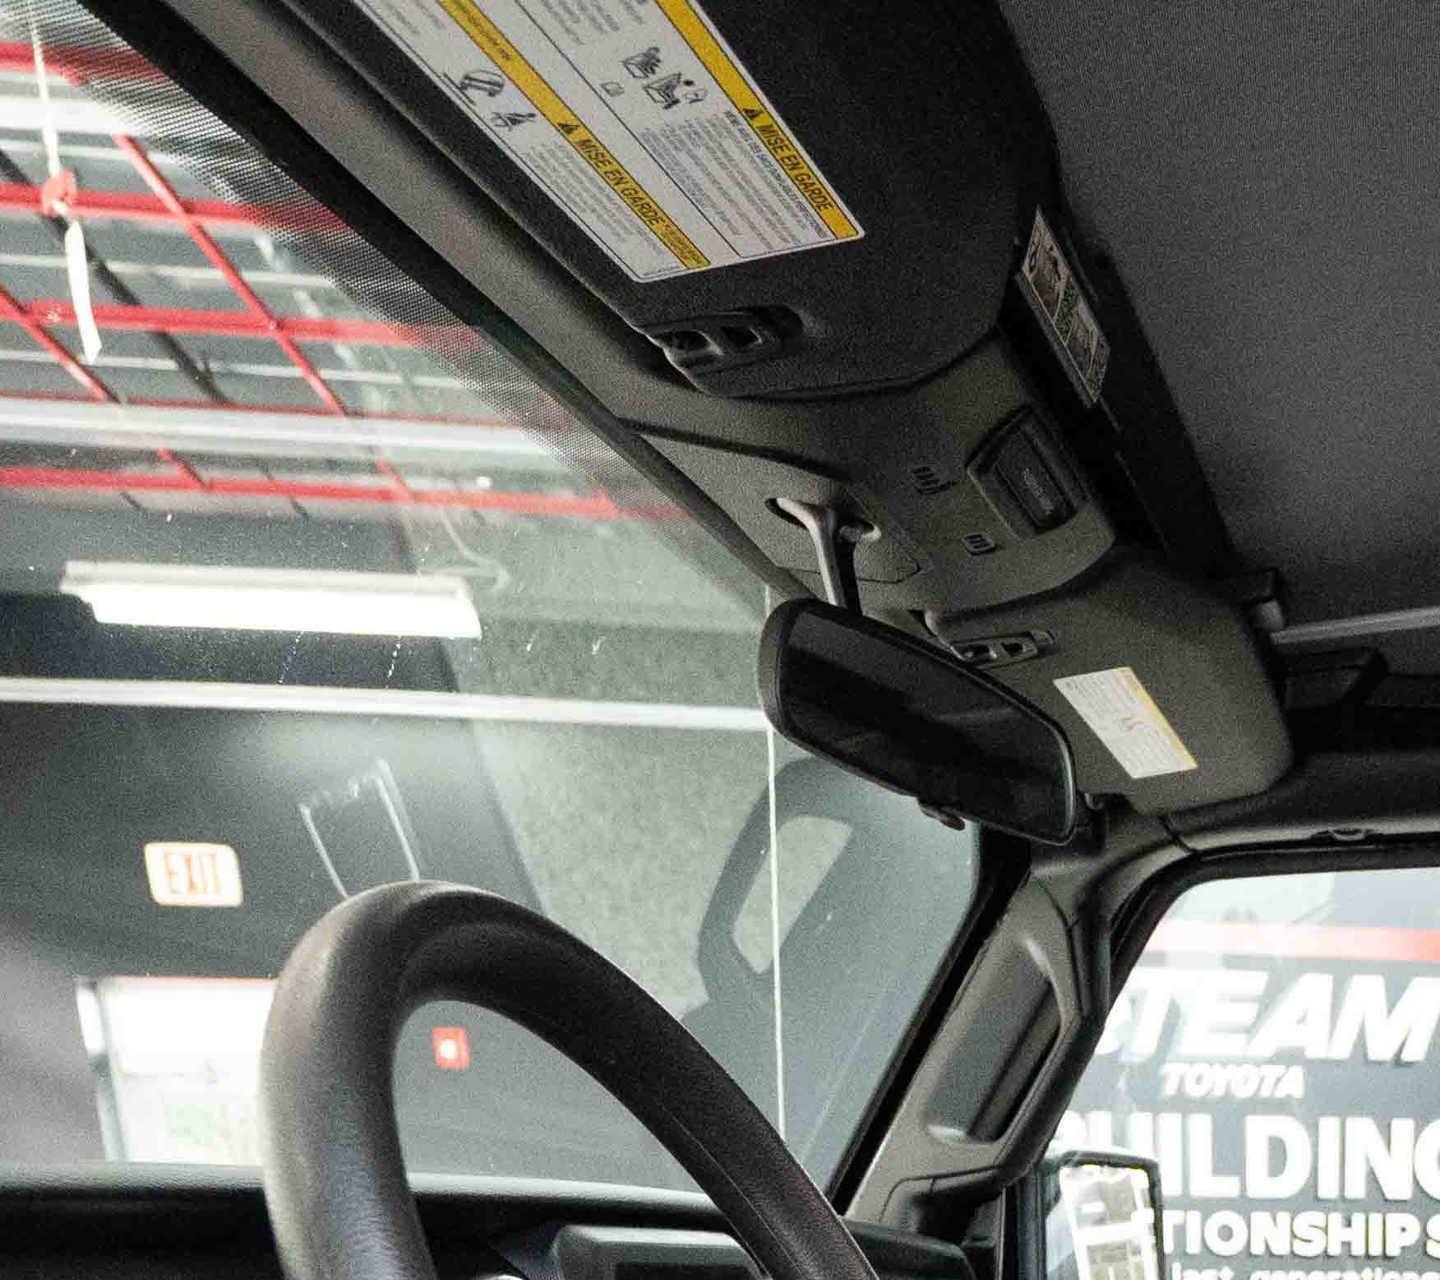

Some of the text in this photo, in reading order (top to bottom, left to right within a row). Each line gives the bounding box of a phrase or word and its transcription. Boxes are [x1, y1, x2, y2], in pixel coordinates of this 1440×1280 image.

[574, 138, 664, 226] MISE EN GARDE
[756, 122, 833, 213] MISE EN GARDE
[162, 851, 223, 896] EXIT
[1162, 1063, 1305, 1099] TOYOTA
